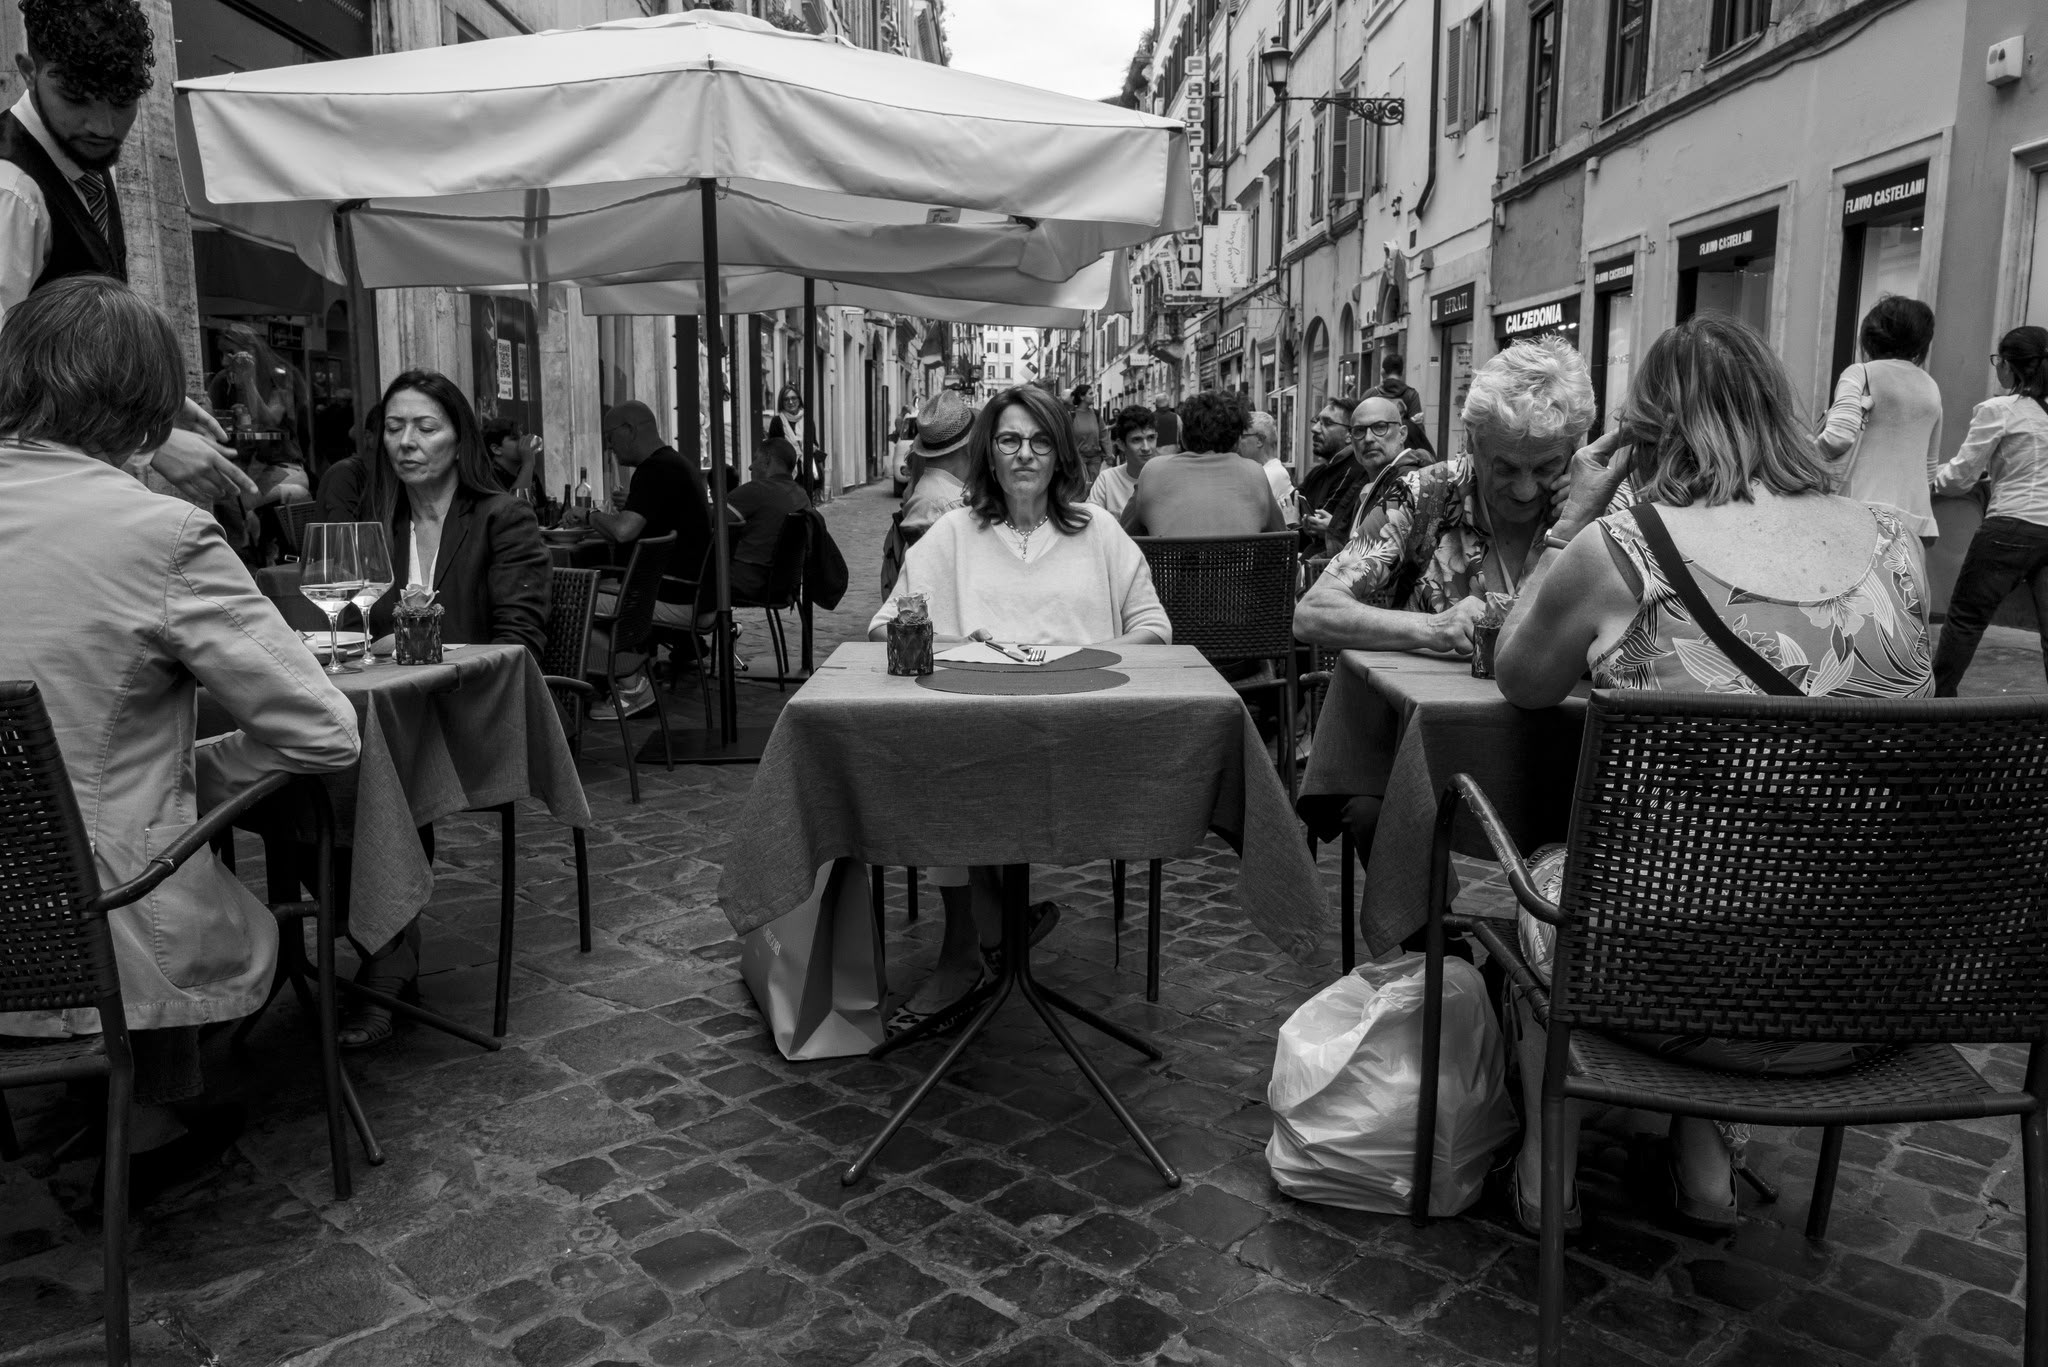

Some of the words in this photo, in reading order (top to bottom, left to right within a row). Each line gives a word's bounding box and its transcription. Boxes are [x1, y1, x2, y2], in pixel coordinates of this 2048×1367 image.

[1844, 194, 1873, 215] FLAVIO
[1874, 178, 1926, 207] CASTELLANI
[1505, 303, 1562, 334] CALZEDONIA
